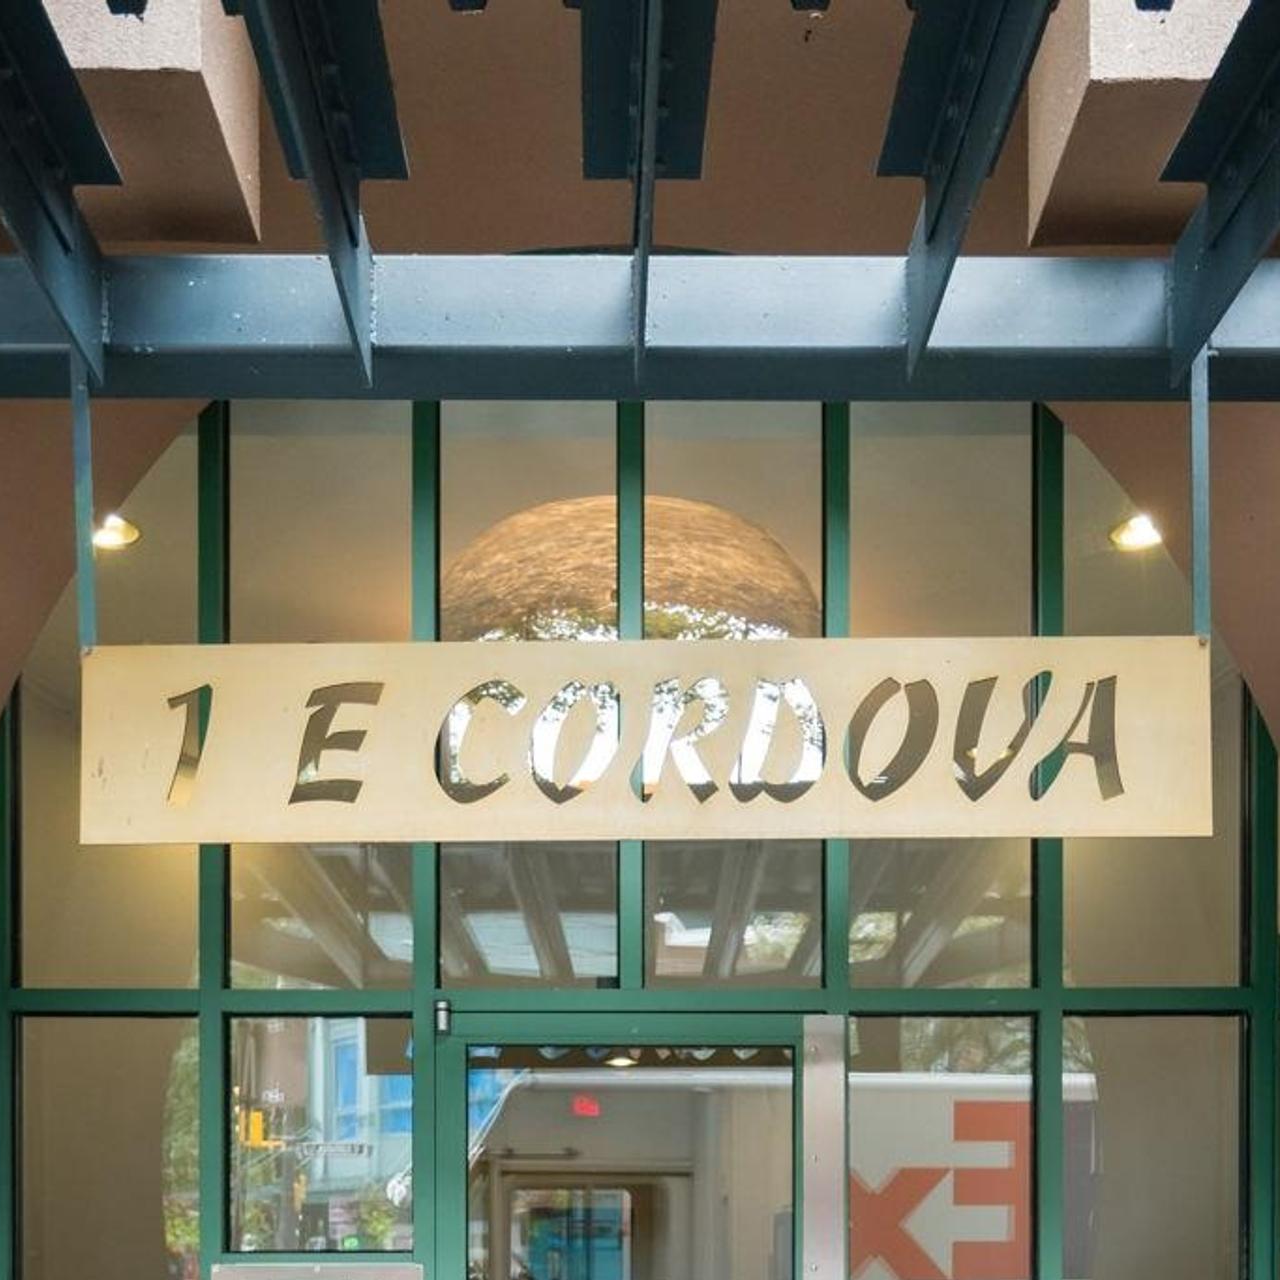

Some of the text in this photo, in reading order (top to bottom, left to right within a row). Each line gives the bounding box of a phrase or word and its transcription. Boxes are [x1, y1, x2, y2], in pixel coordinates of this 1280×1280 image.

[166, 670, 1125, 808] 1 E CORDOVA
